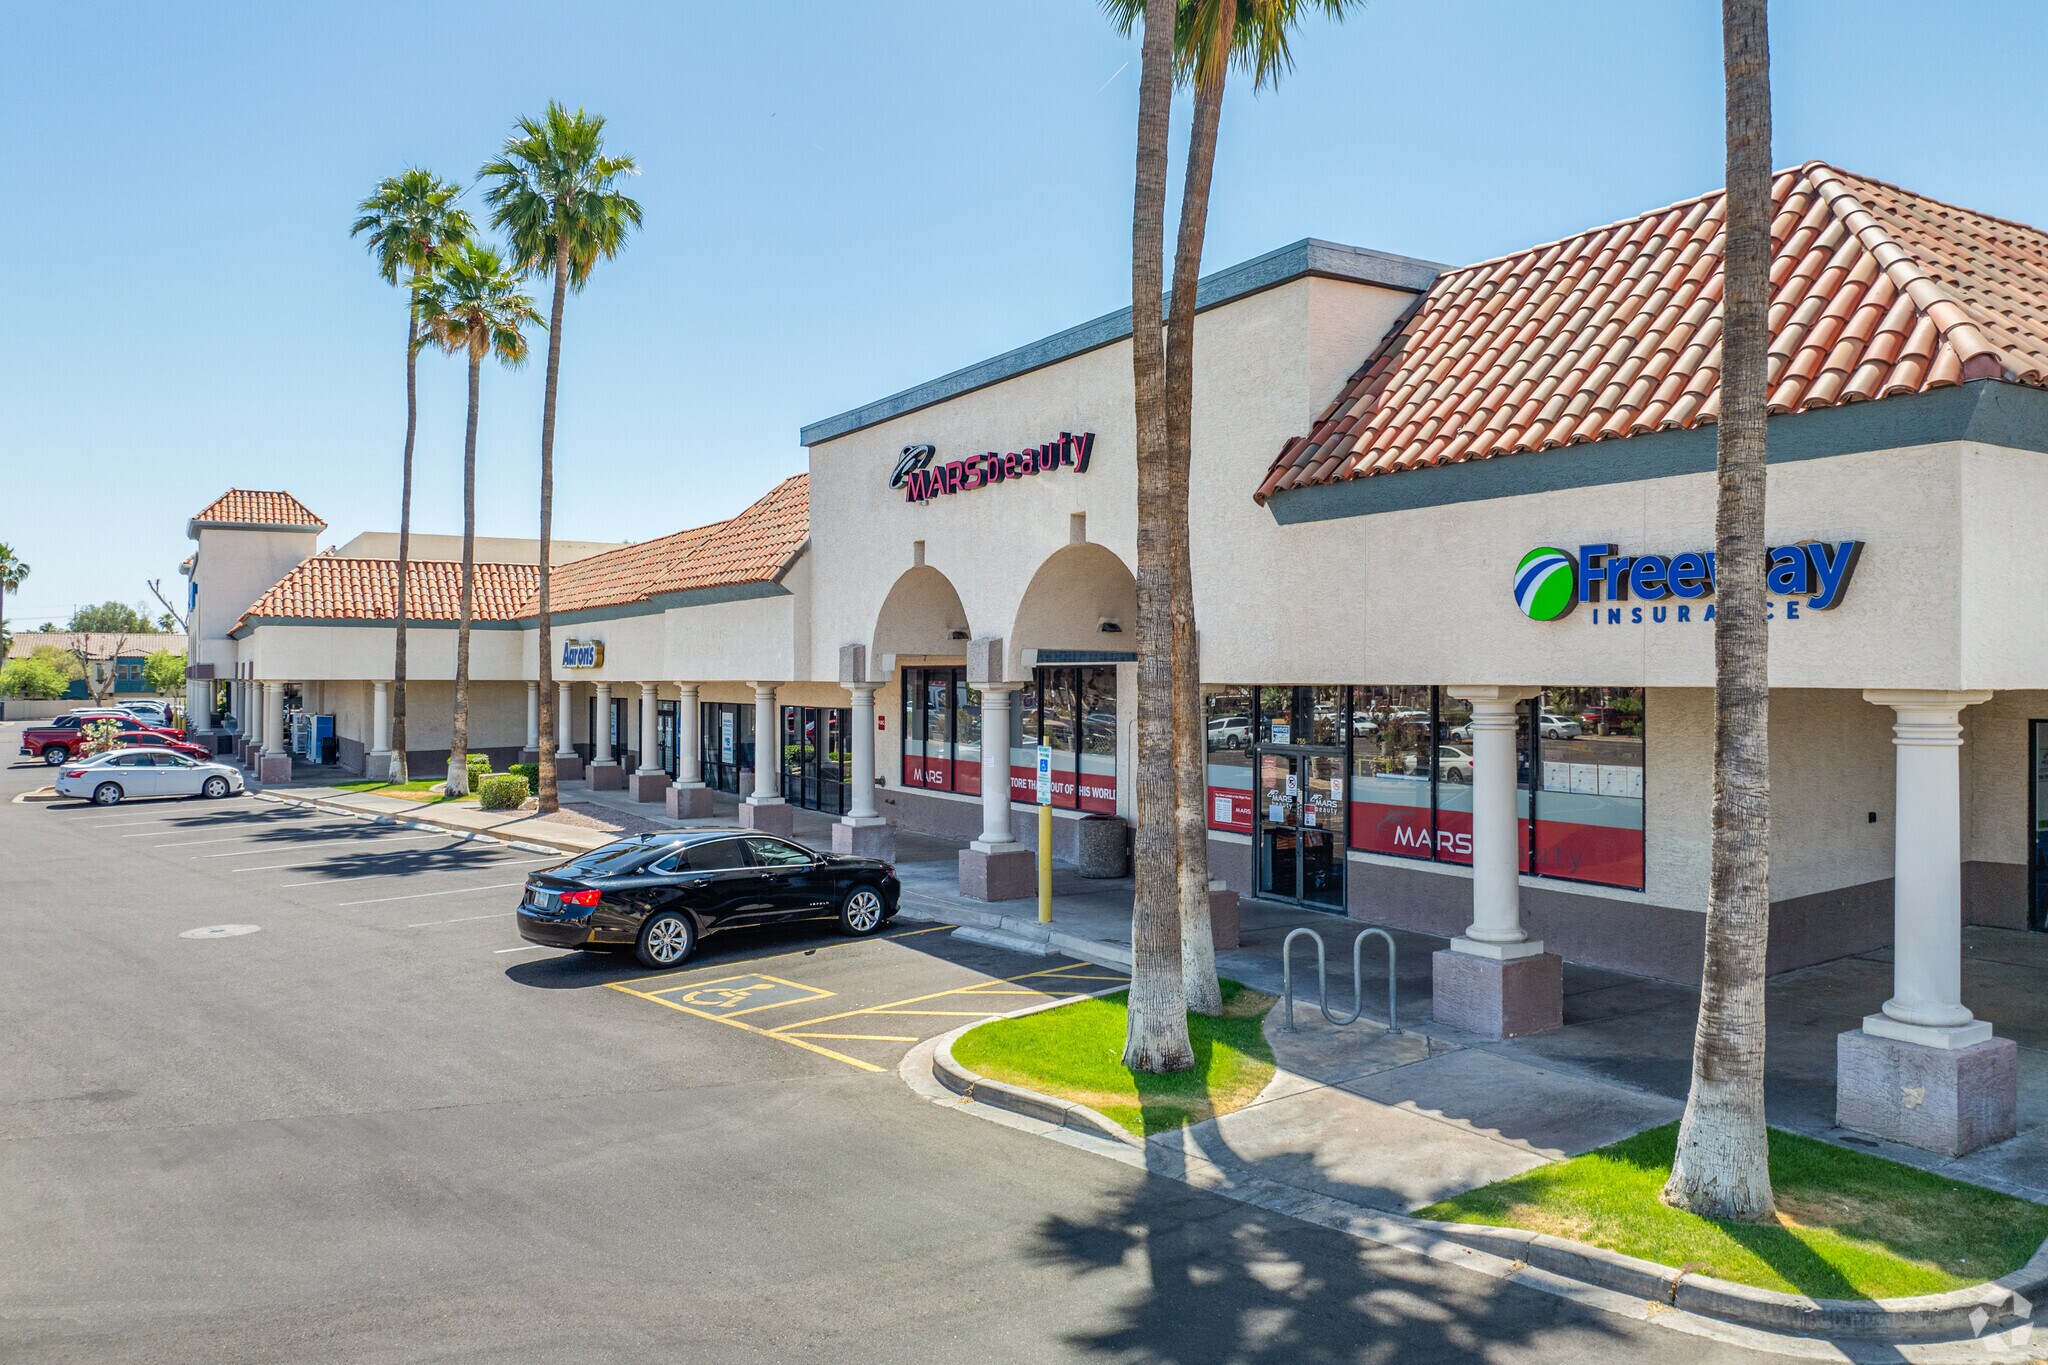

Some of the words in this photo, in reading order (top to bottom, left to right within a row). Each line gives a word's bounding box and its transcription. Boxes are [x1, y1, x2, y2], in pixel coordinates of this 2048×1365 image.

[1579, 540, 1860, 611] Freeay
[1593, 601, 1800, 625] INSURACE
[913, 767, 943, 784] MARS
[1010, 777, 1027, 789] TORE
[1050, 782, 1063, 794] OUT
[1064, 784, 1074, 795] OF
[1078, 785, 1091, 797] HIS
[1272, 795, 1293, 803] MARS
[1315, 800, 1338, 808] MARS
[1393, 825, 1472, 855] MARS
